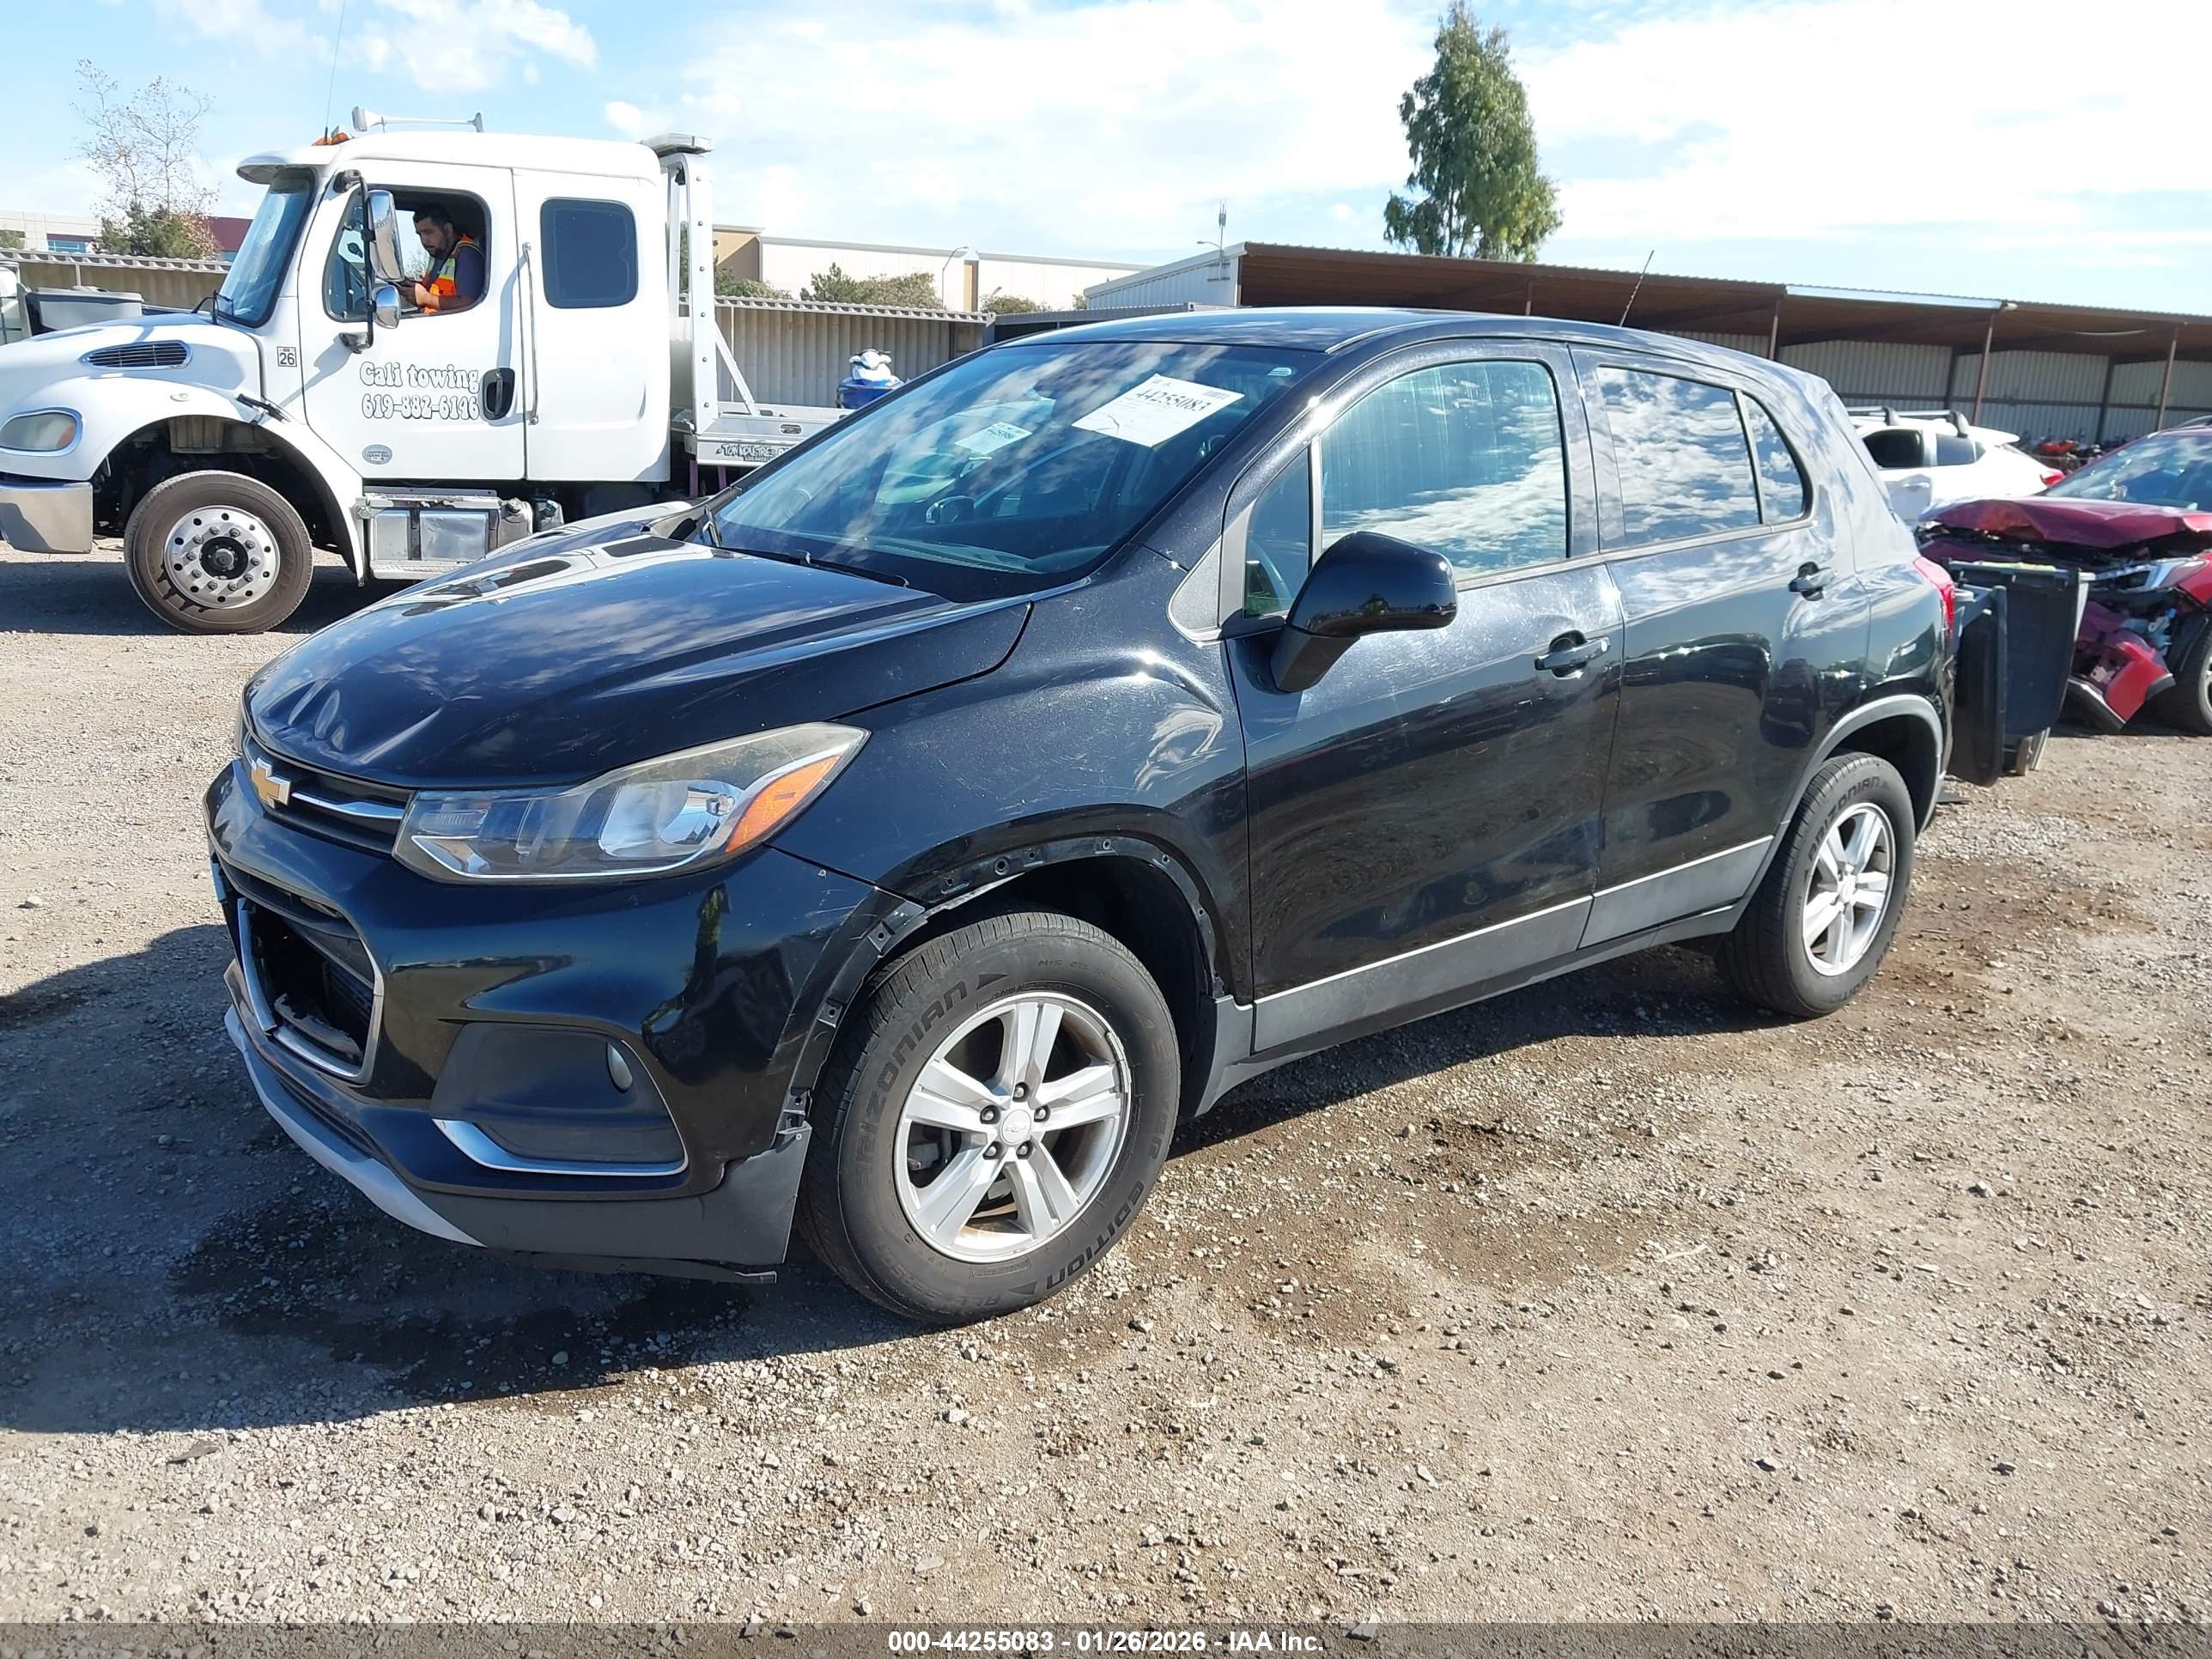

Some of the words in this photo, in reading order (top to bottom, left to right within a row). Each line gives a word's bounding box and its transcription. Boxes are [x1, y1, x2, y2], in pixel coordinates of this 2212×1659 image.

[279, 352, 295, 365] 26
[360, 362, 403, 386] Cali
[407, 364, 479, 394] towing
[362, 393, 479, 420] 619-882-6146
[1135, 388, 1212, 412] 44255083
